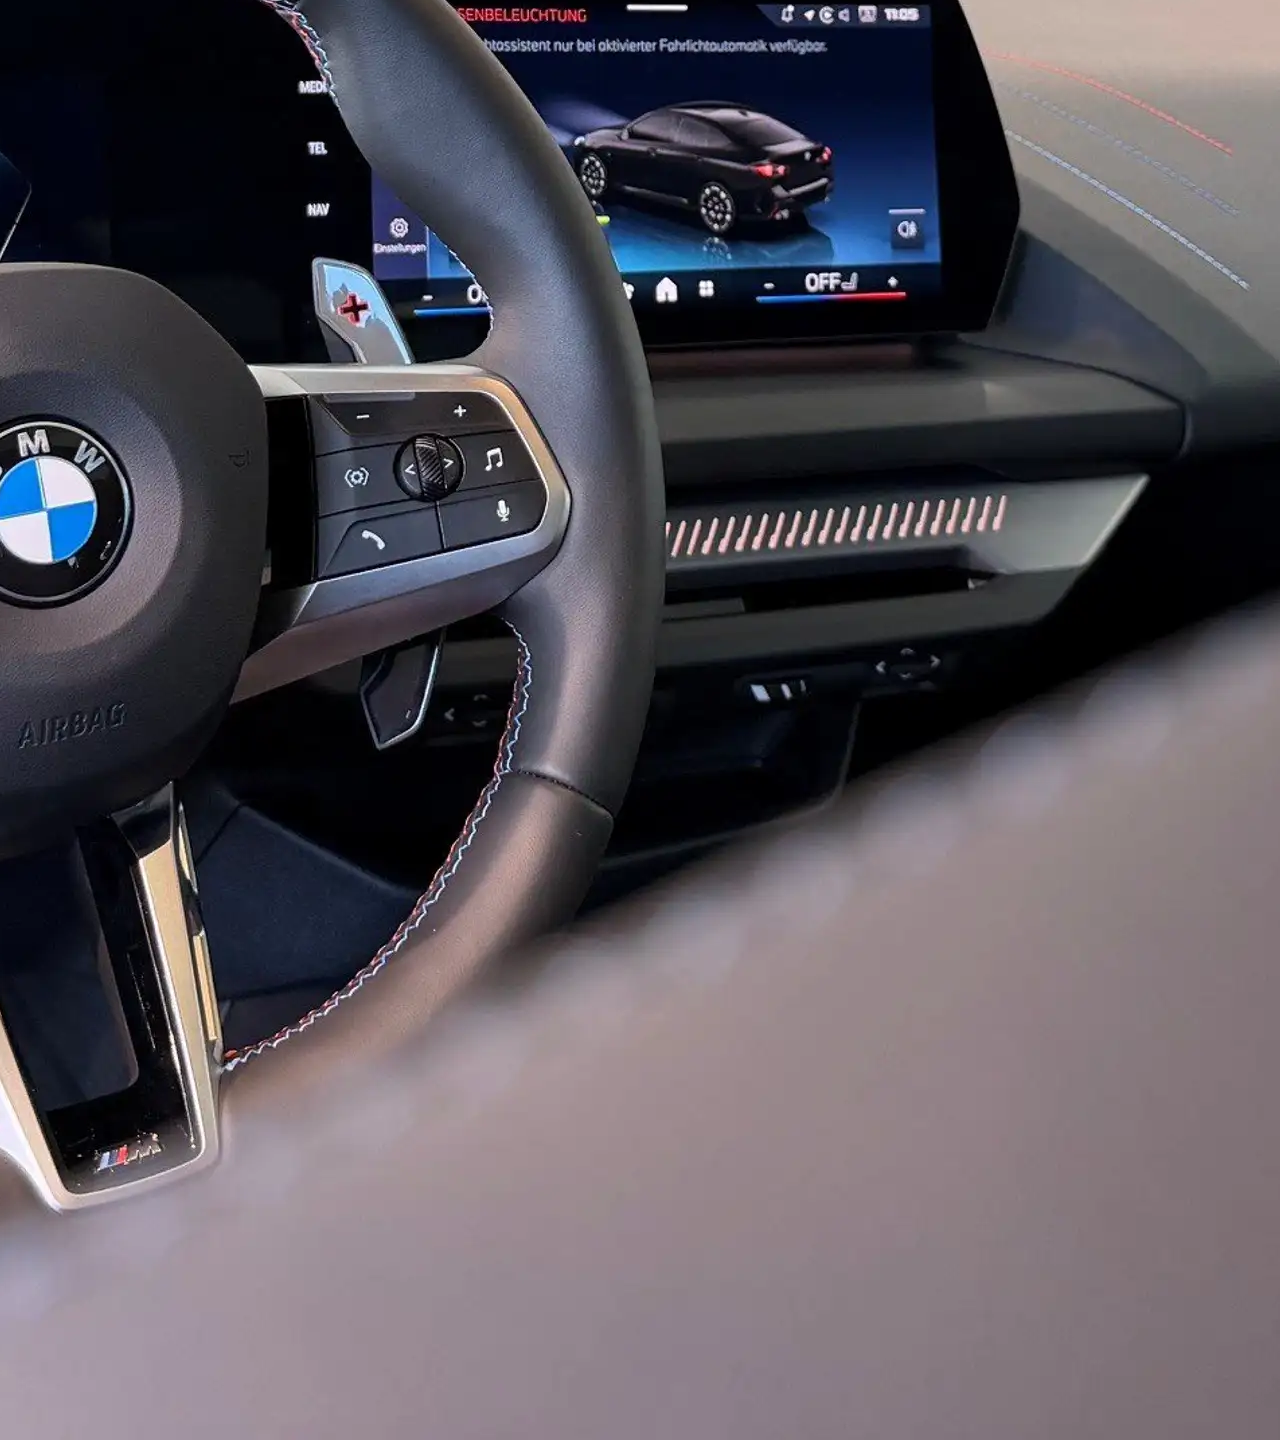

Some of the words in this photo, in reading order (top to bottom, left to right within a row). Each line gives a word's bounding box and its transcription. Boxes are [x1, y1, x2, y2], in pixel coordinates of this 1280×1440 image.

[457, 7, 587, 23] SENBELEUCHTUNG
[884, 6, 920, 21] 11:05
[484, 37, 551, 52] htassistent
[553, 40, 574, 52] nur
[576, 38, 596, 52] bei
[598, 38, 656, 53] aktivierter
[659, 38, 768, 53] Fahrlichtautomatik
[299, 80, 332, 94] MEDI
[307, 141, 328, 155] TEL
[306, 203, 330, 217] NAV
[373, 243, 426, 255] Einstellungen
[805, 272, 841, 293] OFF
[19, 702, 126, 750] AIRBAG
